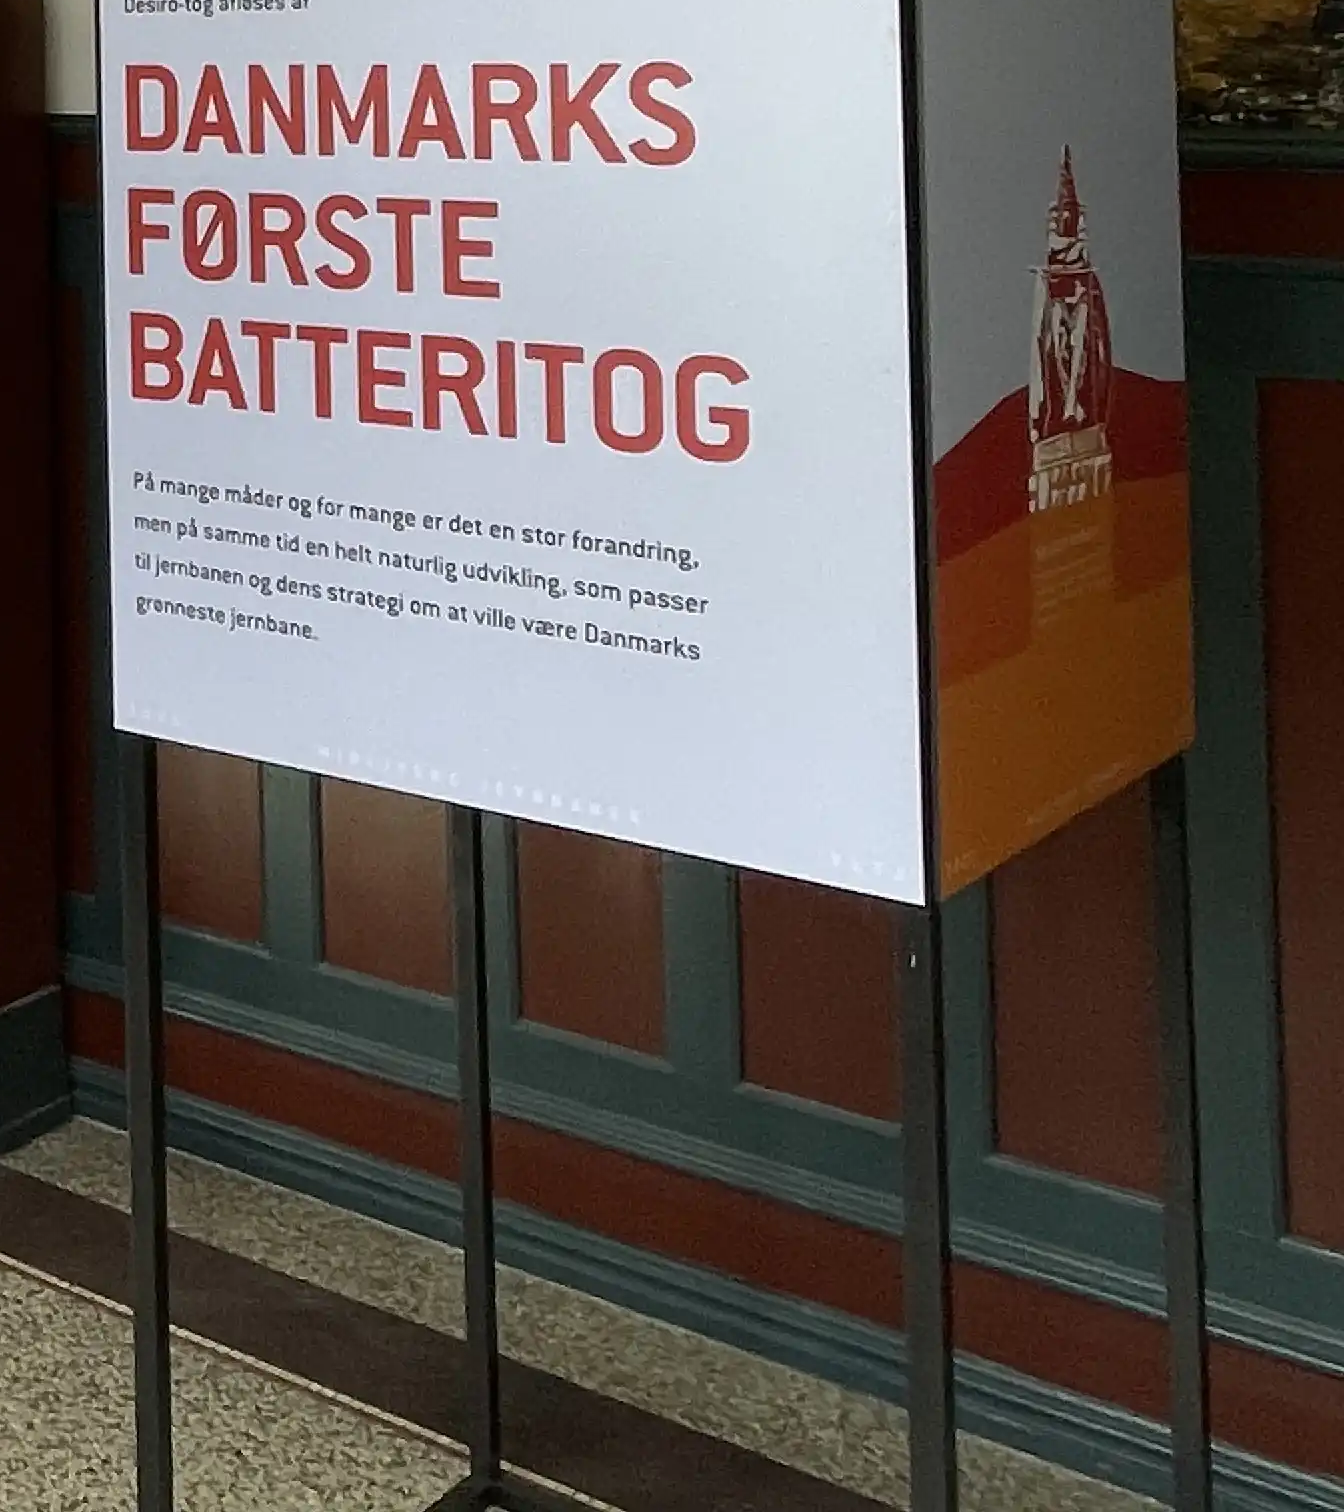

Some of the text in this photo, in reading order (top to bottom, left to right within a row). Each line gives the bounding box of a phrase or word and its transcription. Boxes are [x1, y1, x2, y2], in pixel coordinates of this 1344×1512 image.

[125, 62, 697, 166] DANMARKS
[128, 187, 501, 299] FØRSTE
[130, 311, 751, 463] BATTERITOG
[134, 471, 700, 572] På mange måder og for mange er det en stor forandring,
[134, 515, 709, 614] men på samme tid en helt naturlig udvikling, som passer
[135, 552, 700, 660] til jernbanen og dens strategi om at ville være Danmarks
[229, 606, 319, 640] jernbane.
